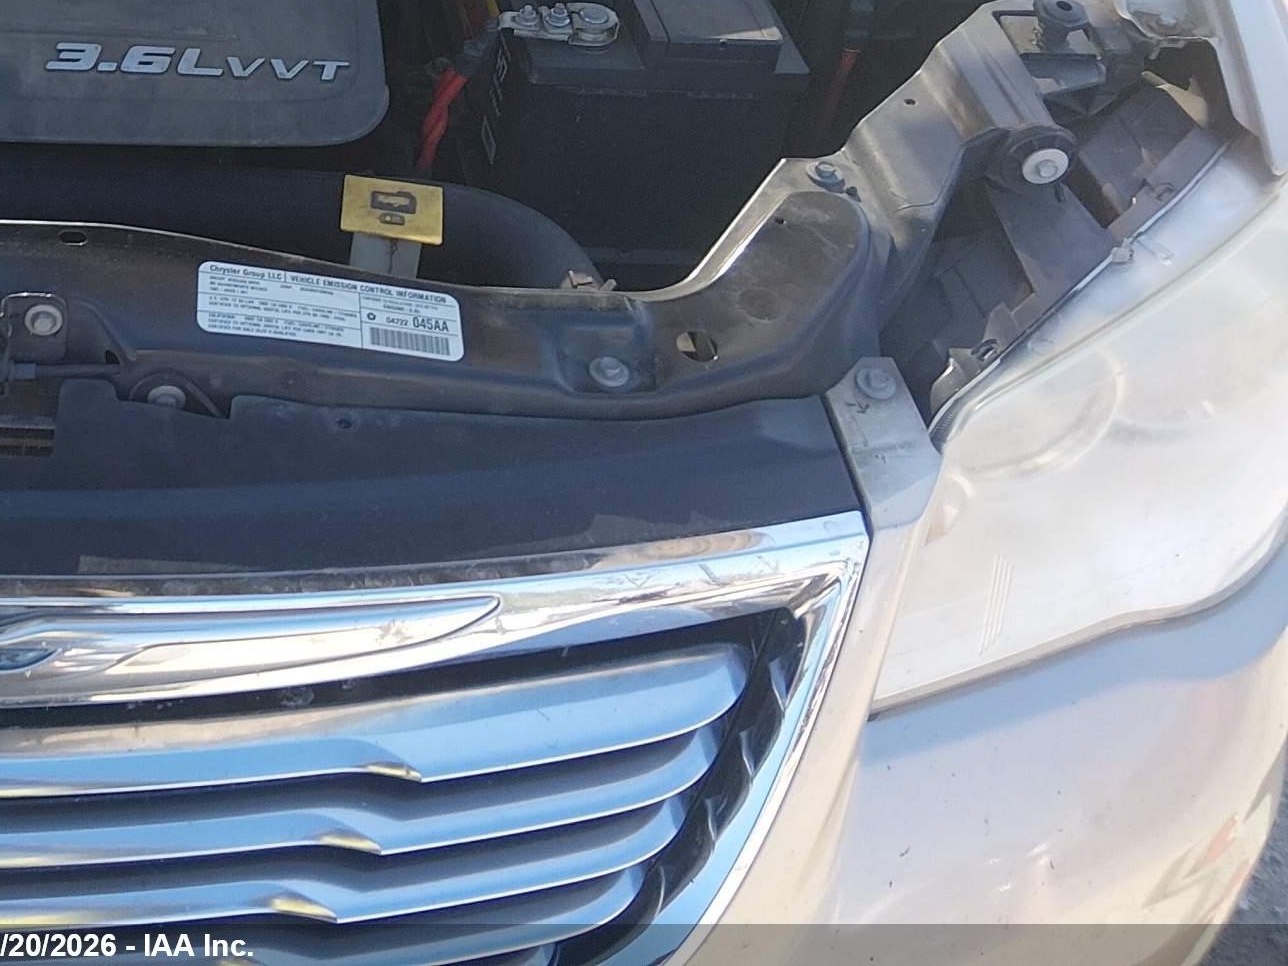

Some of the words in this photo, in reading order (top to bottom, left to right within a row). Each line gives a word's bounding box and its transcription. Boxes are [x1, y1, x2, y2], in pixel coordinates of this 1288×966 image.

[209, 264, 240, 275] Chrysler
[243, 268, 265, 279] Group
[268, 272, 283, 280] LLC
[290, 275, 321, 286] VEHICLE
[323, 279, 358, 291] EMISSION
[360, 284, 394, 296] CONTROL
[396, 290, 447, 304] INFORMATION
[412, 316, 450, 332] 045AA
